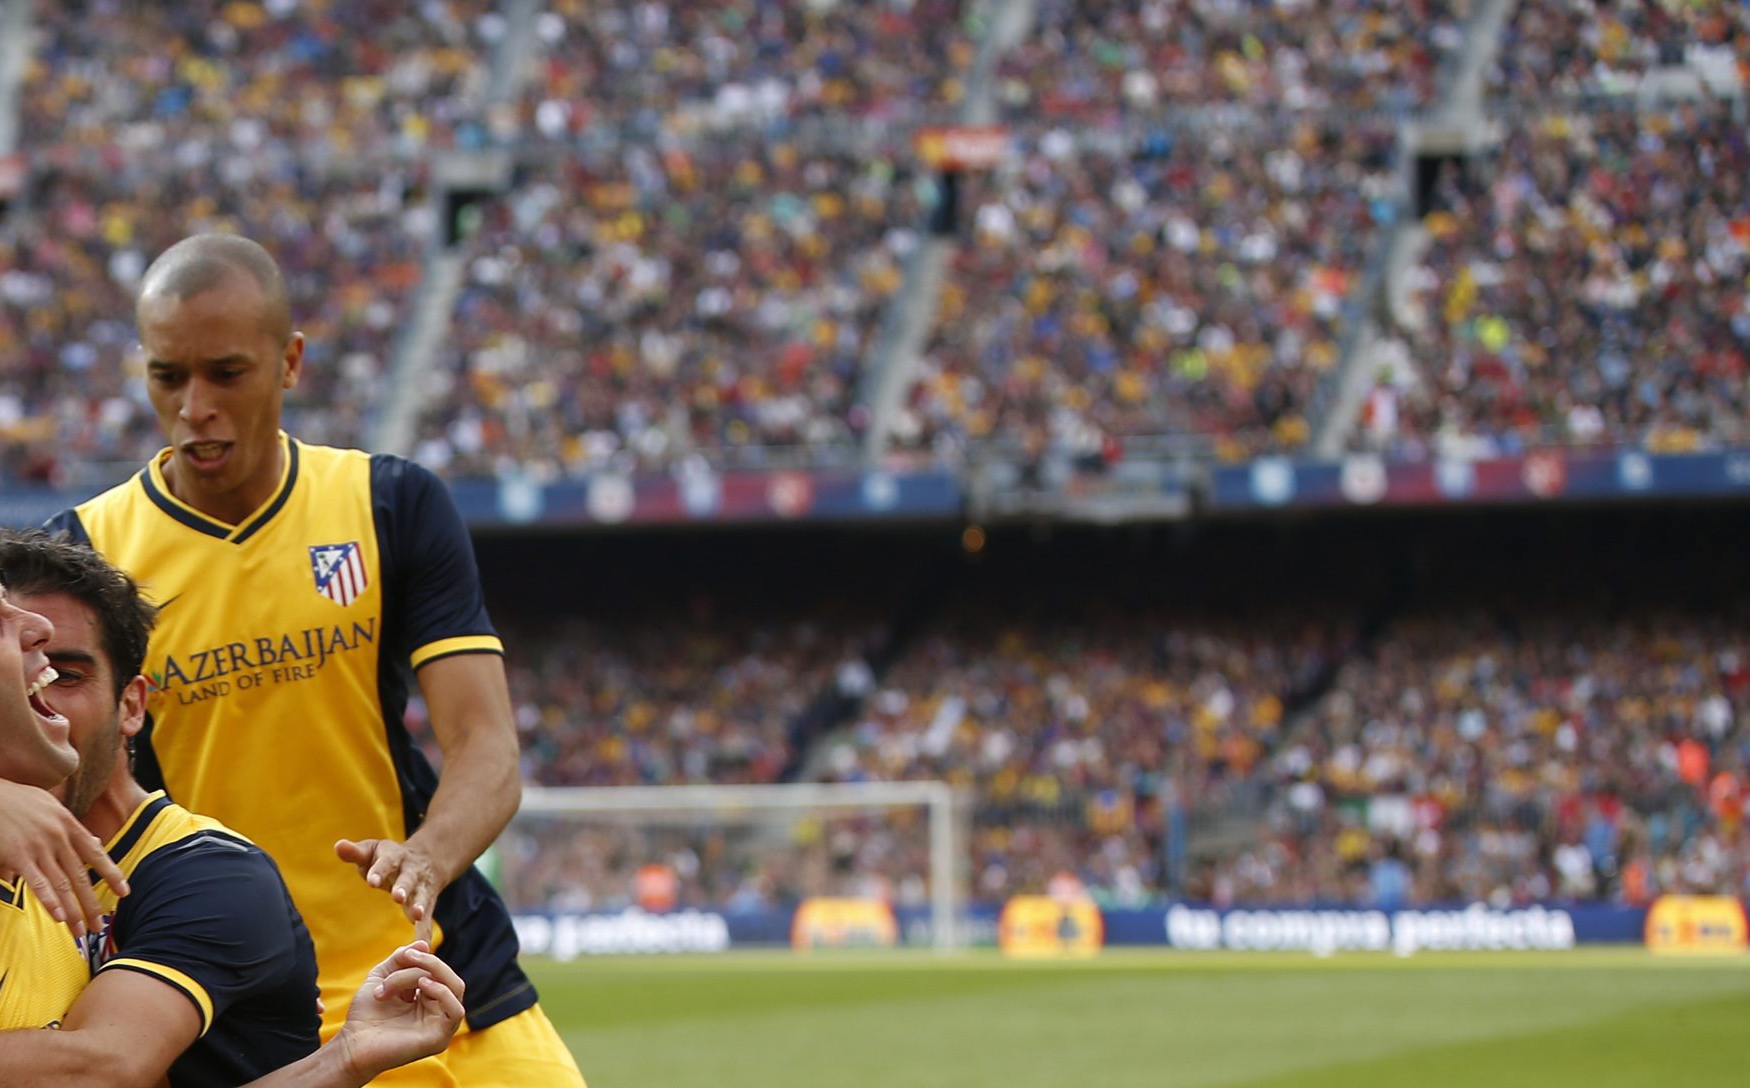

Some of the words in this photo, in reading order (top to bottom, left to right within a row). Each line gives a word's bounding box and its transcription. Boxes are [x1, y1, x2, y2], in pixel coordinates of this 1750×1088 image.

[161, 617, 376, 691] AZERBAIJAN
[177, 681, 231, 706] LAND
[237, 672, 264, 691] OF
[273, 664, 316, 684] FIRE
[1223, 909, 1390, 957] compra
[1392, 902, 1576, 957] perfecta
